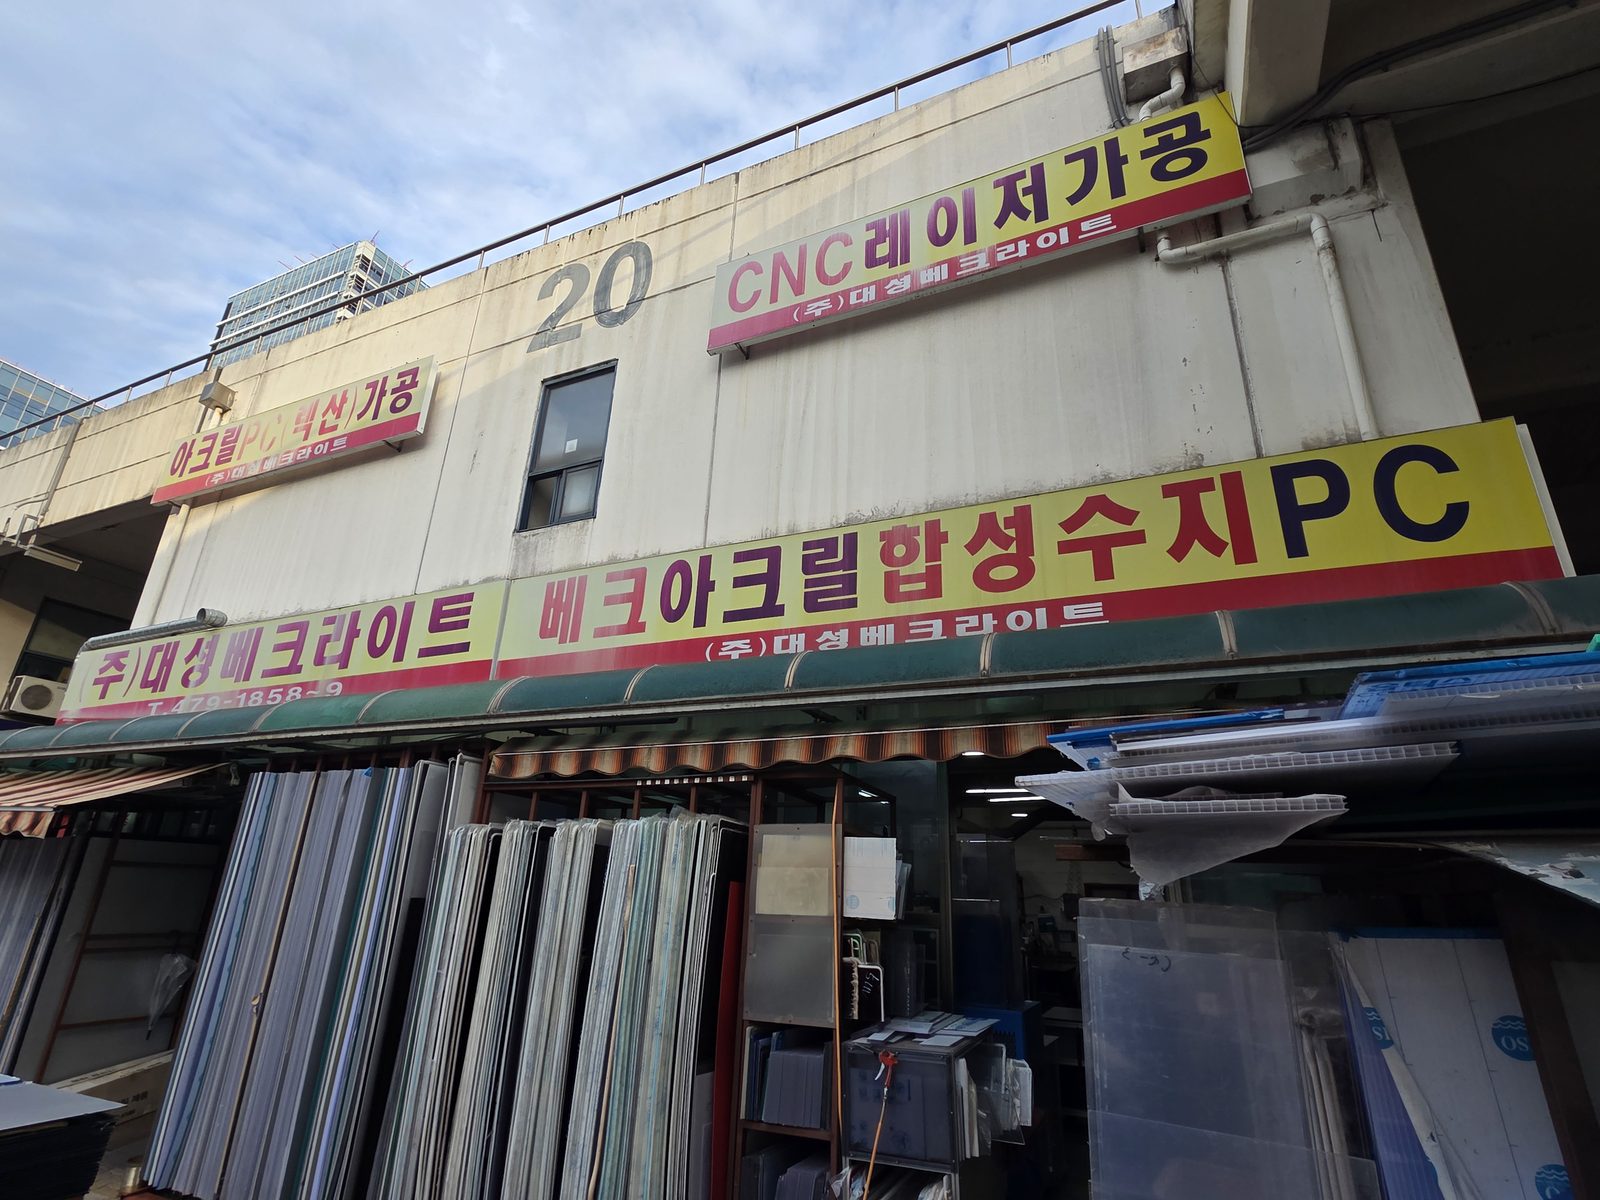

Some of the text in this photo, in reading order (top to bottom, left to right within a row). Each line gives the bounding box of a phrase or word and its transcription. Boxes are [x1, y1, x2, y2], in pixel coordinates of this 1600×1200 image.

[728, 111, 1211, 313] CNC레이저가공
[527, 241, 653, 353] 20
[793, 214, 1117, 322] (주)대성베크라이트
[706, 602, 1109, 661] (주)대성베크라이트
